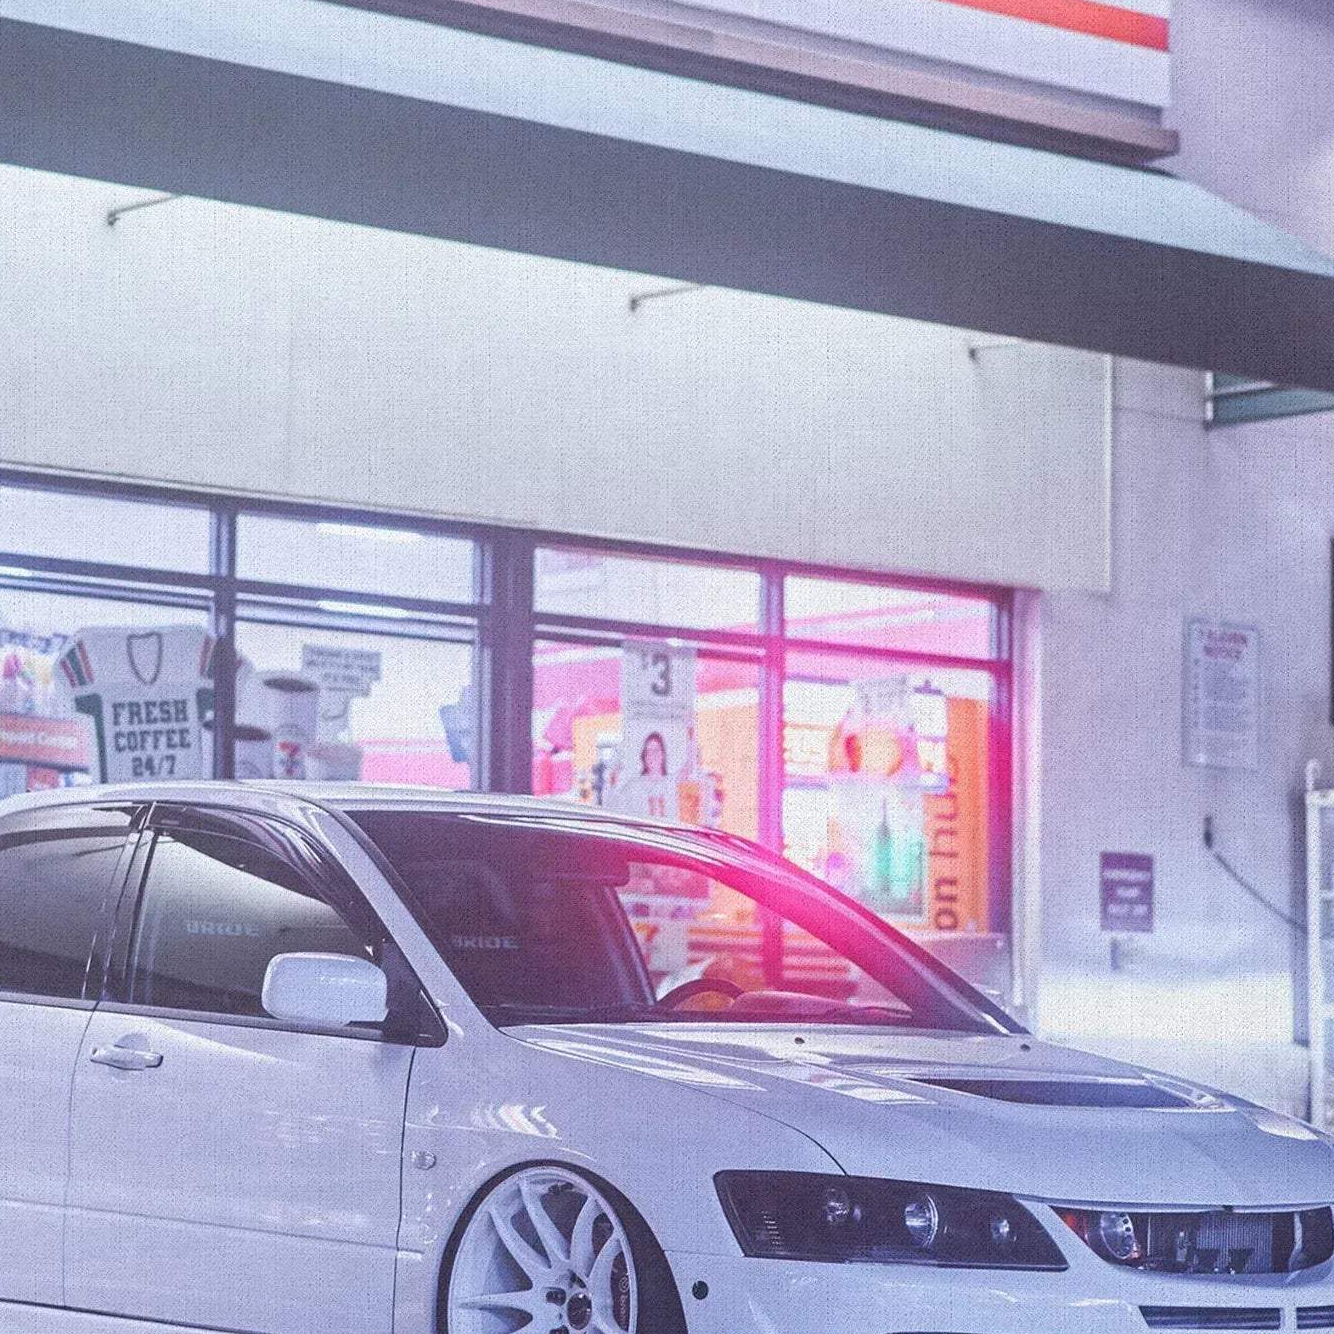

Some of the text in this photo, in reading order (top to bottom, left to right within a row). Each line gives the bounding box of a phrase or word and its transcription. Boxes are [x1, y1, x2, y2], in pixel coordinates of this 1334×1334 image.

[112, 699, 189, 726] FRESH
[114, 728, 192, 752] COFFEE
[131, 754, 177, 777] 24/7
